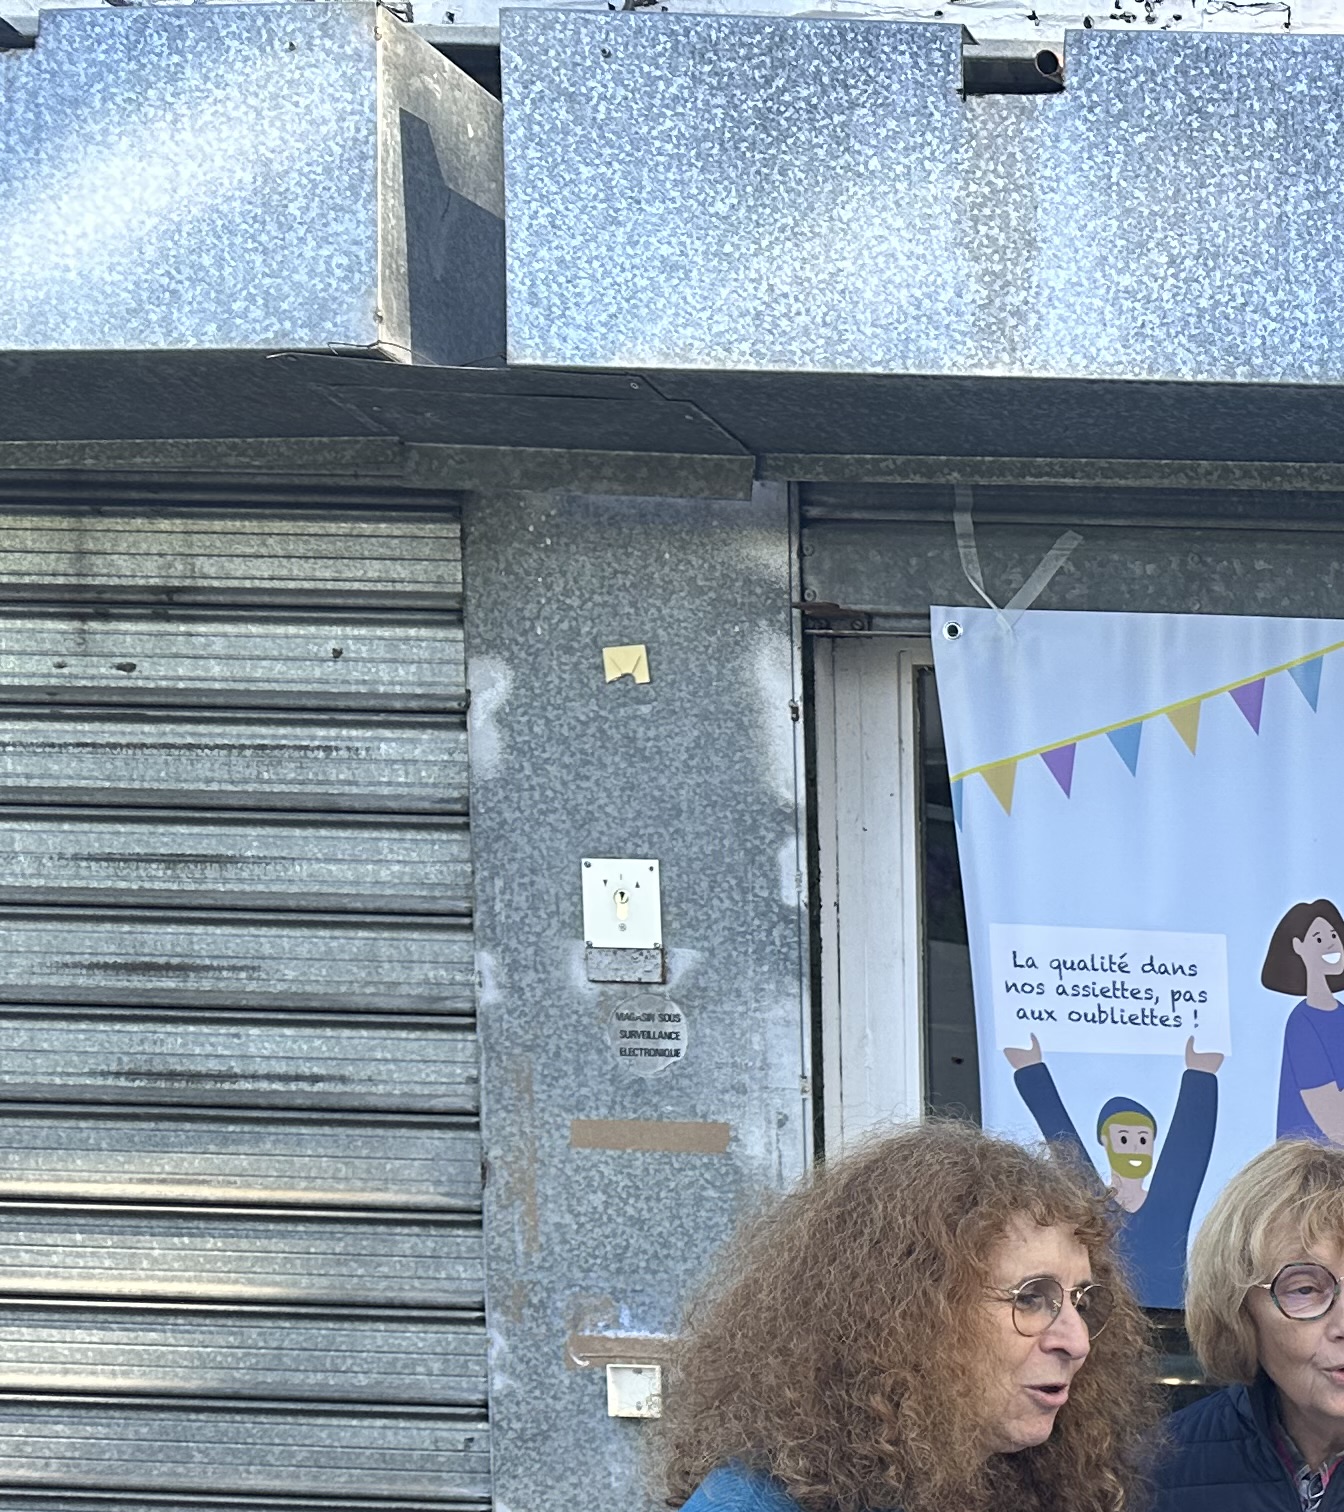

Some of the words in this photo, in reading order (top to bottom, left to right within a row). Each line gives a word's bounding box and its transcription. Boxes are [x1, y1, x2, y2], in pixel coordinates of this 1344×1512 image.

[1012, 950, 1039, 970] La
[1049, 952, 1131, 981] qualité
[1141, 954, 1198, 977] dans
[1004, 979, 1045, 996] nos
[1055, 980, 1160, 1006] assiettes,
[1170, 988, 1208, 1013] pas
[658, 1013, 681, 1023] SOUS
[1016, 1006, 1057, 1022] aux
[1067, 1002, 1183, 1028] oubliettes
[1192, 1009, 1200, 1029] !
[619, 1030, 681, 1040] SURVEILLANCE
[619, 1047, 681, 1057] ELECTRONIQUE
